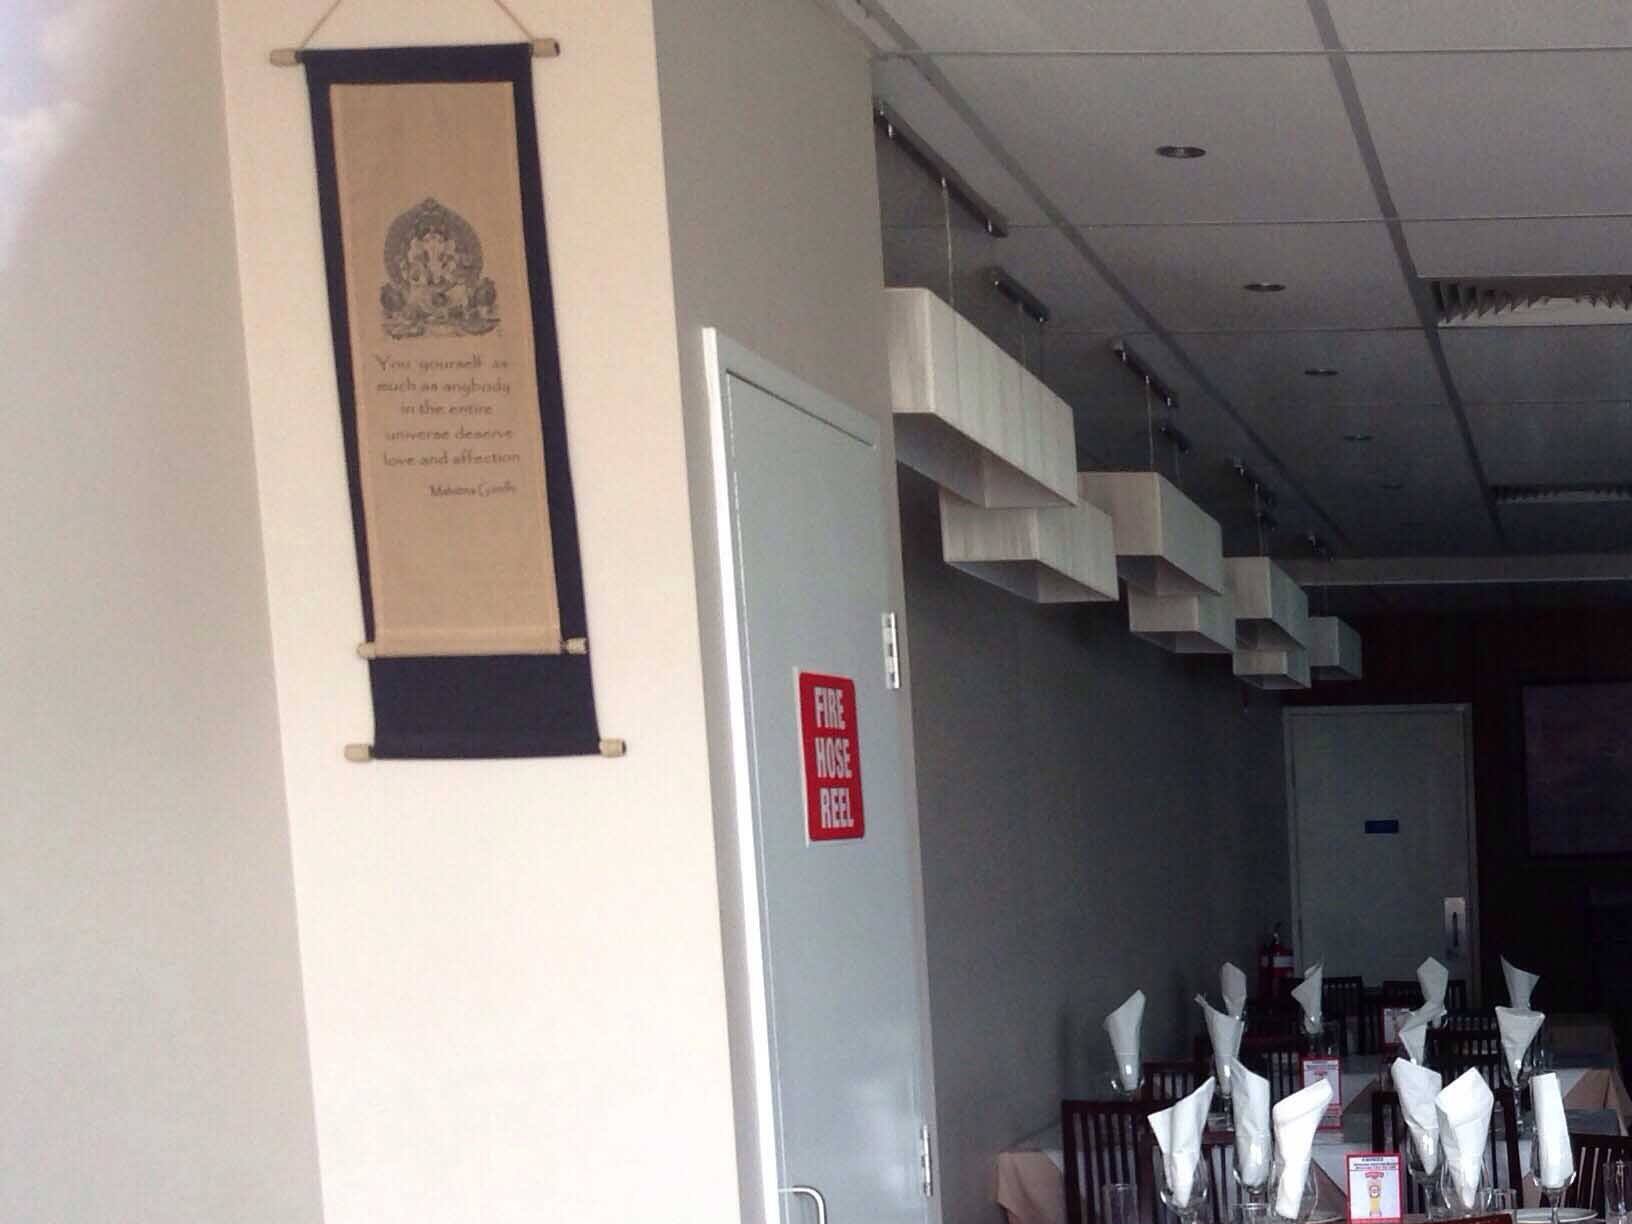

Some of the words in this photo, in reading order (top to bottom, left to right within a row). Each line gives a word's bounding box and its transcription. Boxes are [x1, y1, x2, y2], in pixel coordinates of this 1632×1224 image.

[374, 353, 411, 371] You
[419, 352, 481, 371] yourself
[376, 377, 416, 392] much
[443, 377, 511, 397] anybody
[400, 402, 415, 414] in
[419, 400, 444, 415] the
[448, 404, 493, 415] entire
[386, 429, 449, 440] universe
[455, 424, 513, 440] deserve
[384, 451, 416, 466] love
[419, 450, 449, 464] and
[452, 449, 520, 464] affection
[813, 686, 846, 730] FIRE
[814, 737, 852, 778] HOSE
[820, 787, 854, 829] REEL
